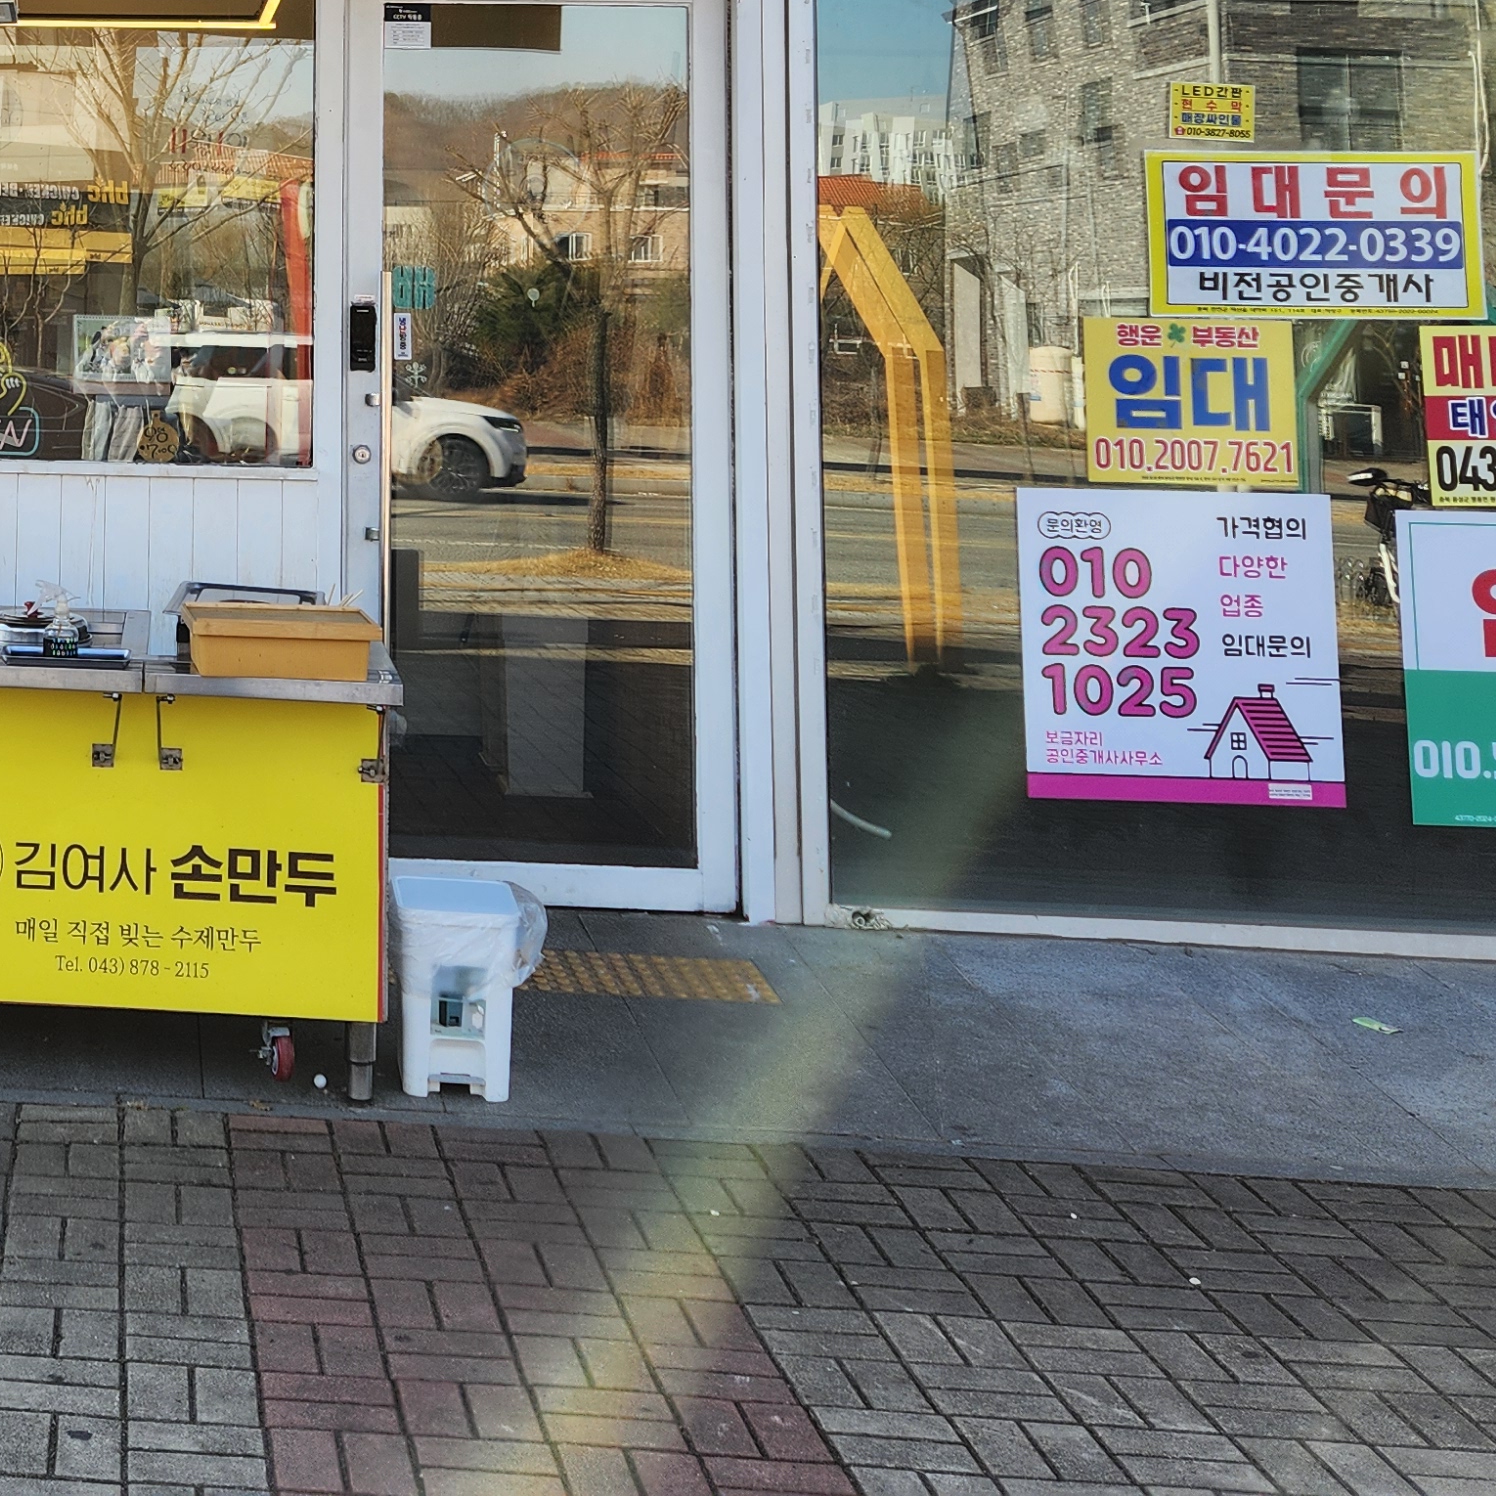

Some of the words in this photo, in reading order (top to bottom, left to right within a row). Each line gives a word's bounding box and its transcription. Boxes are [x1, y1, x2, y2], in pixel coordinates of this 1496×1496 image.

[1178, 164, 1448, 219] 임대문의
[1169, 224, 1462, 263] 010-4022-0339
[1199, 270, 1435, 303] 비전공인중개사
[1116, 323, 1163, 348] 행운
[1191, 324, 1260, 350] 부동산
[1432, 334, 1496, 389] 매
[1107, 353, 1271, 433] 임대
[1449, 397, 1496, 438] 태
[1094, 437, 1295, 475] 010.2007.7621
[1046, 517, 1104, 535] 문의환영
[1216, 516, 1307, 541] 가격협의
[1038, 546, 1152, 599] 010
[1218, 555, 1288, 580] 다양한
[1220, 593, 1264, 618] 업종
[1040, 604, 1200, 659] 2323
[1221, 633, 1312, 658] 임대문의
[1041, 662, 1197, 718] 1025
[1045, 730, 1103, 747] 보금자리
[1045, 747, 1163, 766] 공인중개사사무소
[1413, 739, 1496, 780] 010.
[13, 841, 157, 895] 김여사
[170, 844, 337, 907] 손만두
[15, 917, 60, 945] 매일
[67, 920, 110, 947] 직접
[119, 922, 164, 949] 빚는
[170, 923, 262, 953] 수제만두
[55, 954, 83, 973] Tel.
